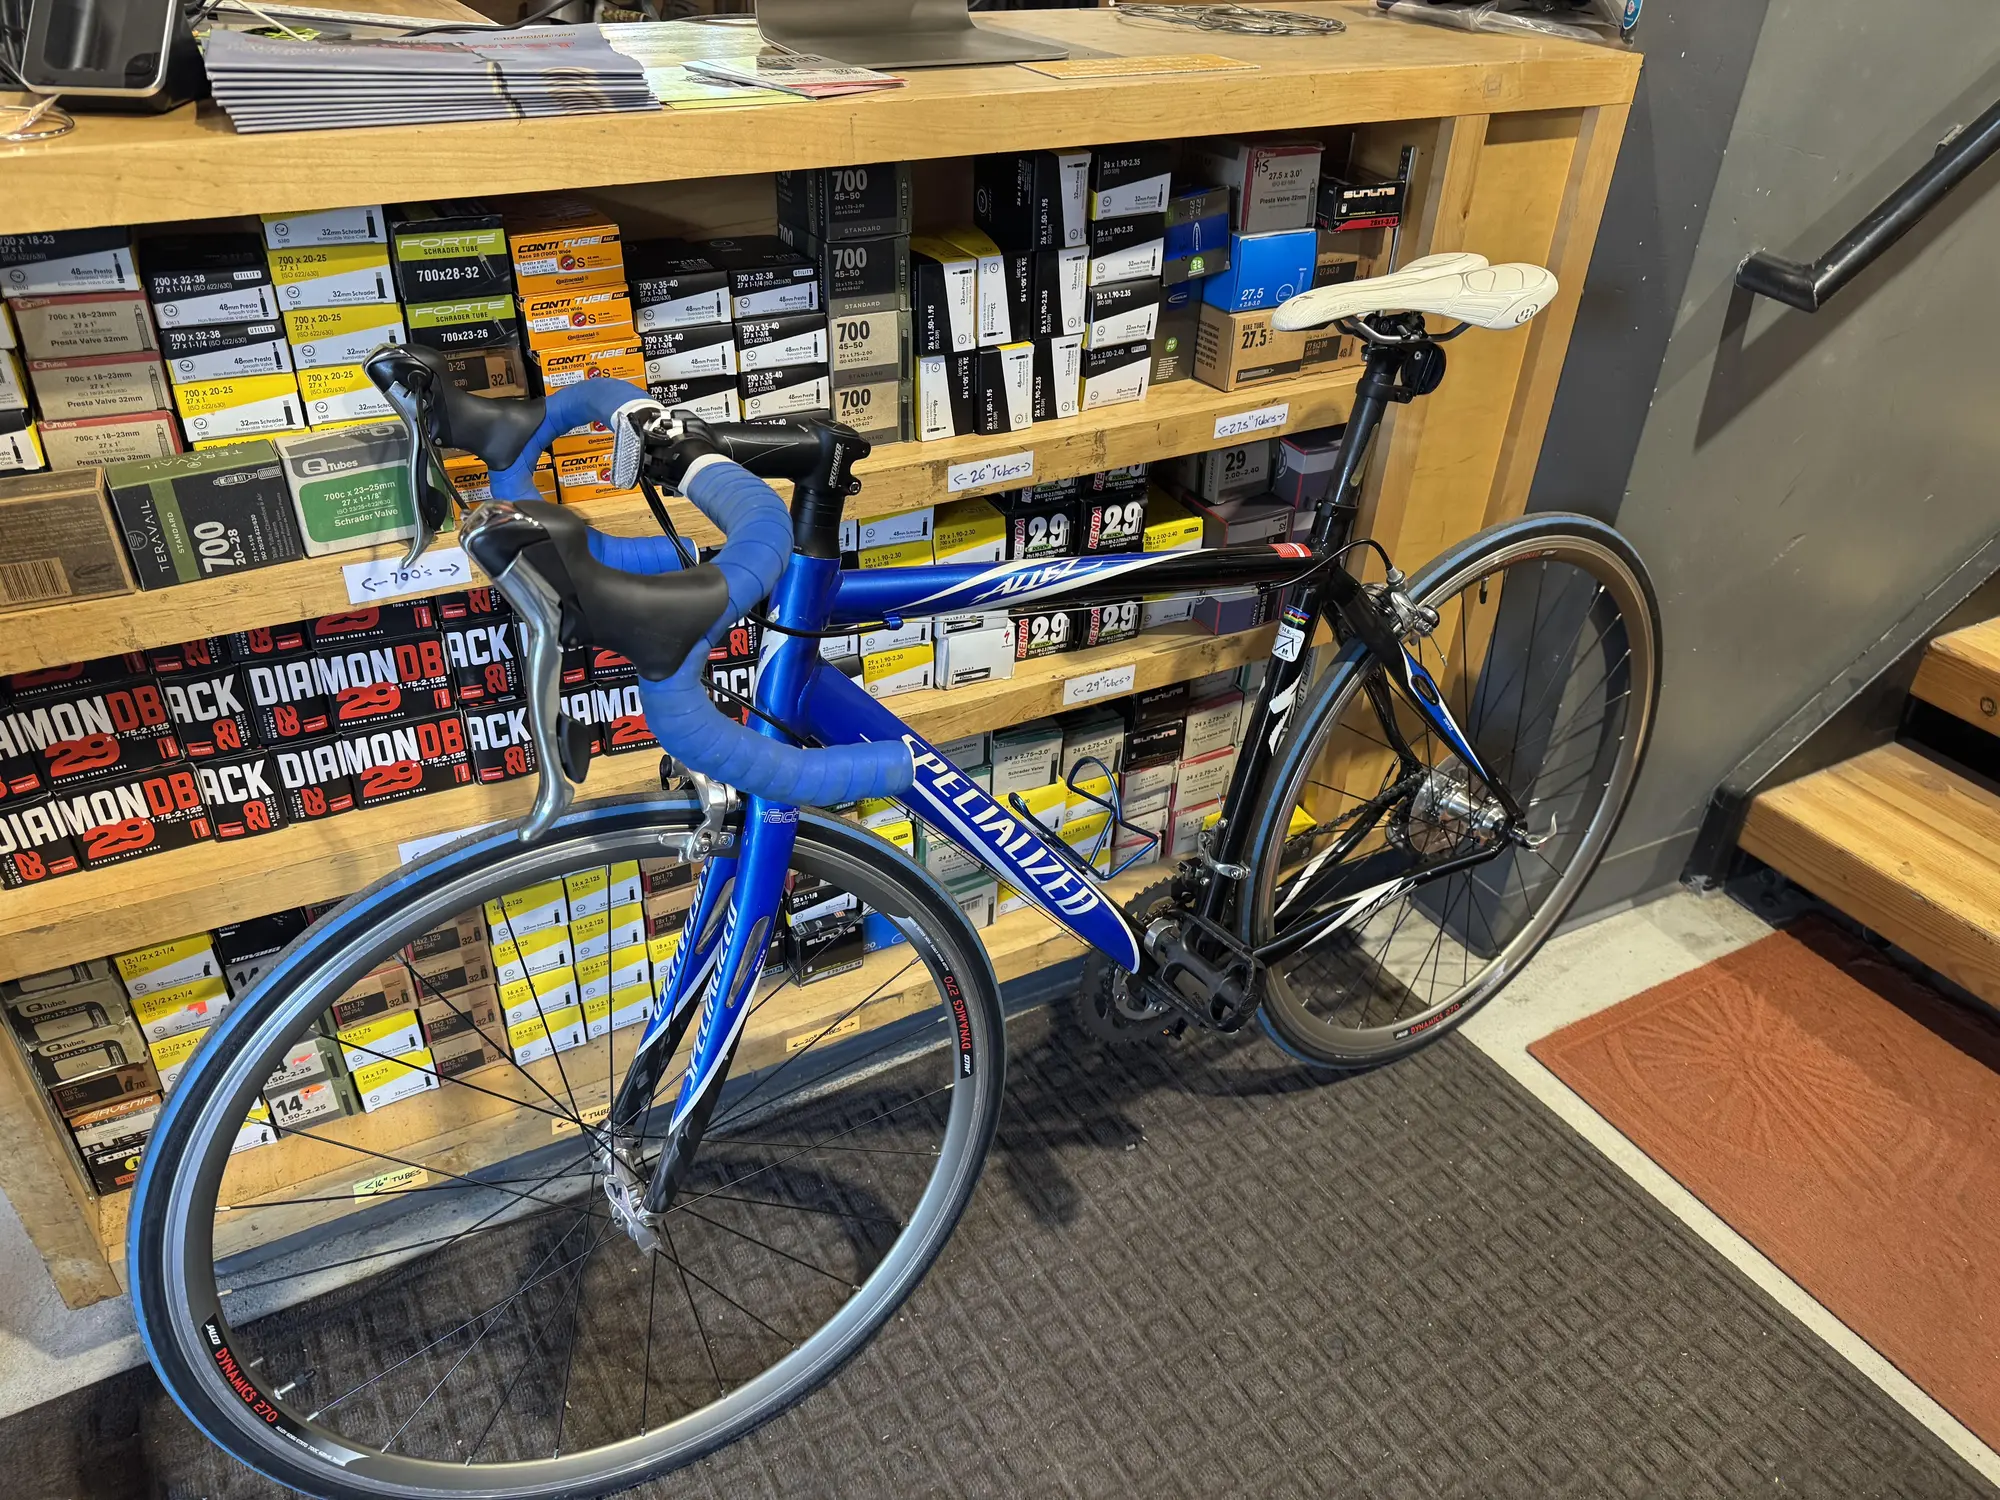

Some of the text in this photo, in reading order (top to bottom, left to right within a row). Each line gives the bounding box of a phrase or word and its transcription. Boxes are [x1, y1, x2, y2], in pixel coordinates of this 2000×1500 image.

[832, 169, 868, 192] 700
[834, 192, 861, 200] 45-50
[321, 228, 367, 236] 32mm Schrader
[844, 225, 881, 234] STANDARD
[518, 241, 559, 254] CONTI
[562, 236, 601, 248] TUBE
[1040, 237, 1047, 245] 26
[423, 245, 478, 255] SCHRADER TUBE
[832, 247, 867, 270] 700
[153, 276, 171, 286] 700
[180, 274, 206, 284] 32-38
[234, 270, 261, 280] UTILITY
[416, 266, 480, 282] 700x28-32
[834, 269, 860, 278] 45-50
[172, 285, 192, 293] 1-1/4
[638, 282, 652, 291] 700
[659, 279, 679, 289] 35-40
[352, 290, 376, 298] Schrader
[1240, 288, 1264, 301] 27.5
[219, 302, 258, 311] 48mm Presta
[530, 299, 571, 312] CONTI
[573, 293, 611, 305] TUBE
[686, 304, 701, 312] 48mm
[844, 301, 880, 310] STANDARD
[294, 316, 310, 325] 700
[318, 313, 342, 322] 20-25
[435, 312, 488, 323] SCHRADER TUBE
[588, 313, 597, 325] S
[248, 325, 275, 335] UTILITY
[837, 320, 870, 343] 700
[1242, 321, 1265, 331] BIKE TUBE
[51, 335, 129, 347] Presta Valve 32mm
[441, 329, 489, 343] 700x23-26
[1241, 329, 1268, 349] 27.5
[839, 341, 864, 350] 45-50
[547, 354, 586, 366] CONTI
[589, 348, 627, 360] TUBE
[691, 358, 706, 366] 48mm
[67, 395, 143, 408] Presta Valve 32mm
[840, 388, 871, 410] 700
[842, 407, 865, 417] 45-50
[127, 453, 151, 461] 32mm
[561, 456, 599, 467] CONTI
[828, 442, 843, 487] SPECIALIZED
[1225, 450, 1247, 473] 29
[992, 464, 1020, 479] Tubes
[1225, 466, 1260, 480] 2.00-2.40
[323, 491, 346, 501] 700c
[334, 508, 399, 527] Schrader Valve
[1102, 501, 1142, 538] 29
[166, 511, 185, 554] STANDARD
[1027, 513, 1069, 548] 29
[1088, 506, 1102, 549] KENDA
[140, 499, 170, 572] TERAVAIL
[1014, 518, 1026, 561] KENDA
[193, 521, 235, 573] 700
[227, 528, 247, 566] 20-28
[980, 558, 1092, 603] ALLEZ
[1103, 600, 1138, 633] 29
[1031, 612, 1069, 645] 29
[1087, 607, 1100, 646] KENDA
[1017, 618, 1029, 658] KENDA
[398, 676, 447, 690] 1.75-2.125
[1103, 676, 1125, 688] Tubes
[335, 682, 401, 720] 29
[115, 722, 171, 740] 1.75-2.125
[45, 732, 121, 777] 29
[419, 751, 466, 766] 1.75-2.125
[1008, 765, 1046, 777] Schrader Valve
[53, 774, 85, 785] PREMIUM
[150, 805, 203, 823] 1.75-2.125
[901, 733, 1100, 916] SPECIALIZED
[83, 816, 155, 860] 29
[585, 875, 601, 886] 2.125
[461, 935, 473, 945] 32
[122, 953, 147, 966] 12-1/2
[154, 946, 175, 957] 2-1/4
[943, 975, 961, 999] 270
[959, 998, 972, 1050] DYNAMICS
[1410, 1012, 1444, 1035] DYNAMICS
[1445, 1002, 1461, 1017] 270
[156, 1043, 181, 1055] 12-1/2
[275, 1095, 303, 1117] 14
[279, 1103, 327, 1123] 1.50-2.25
[391, 1168, 422, 1184] TUBES
[205, 1323, 279, 1424] JALCO DYNAMICS 270
